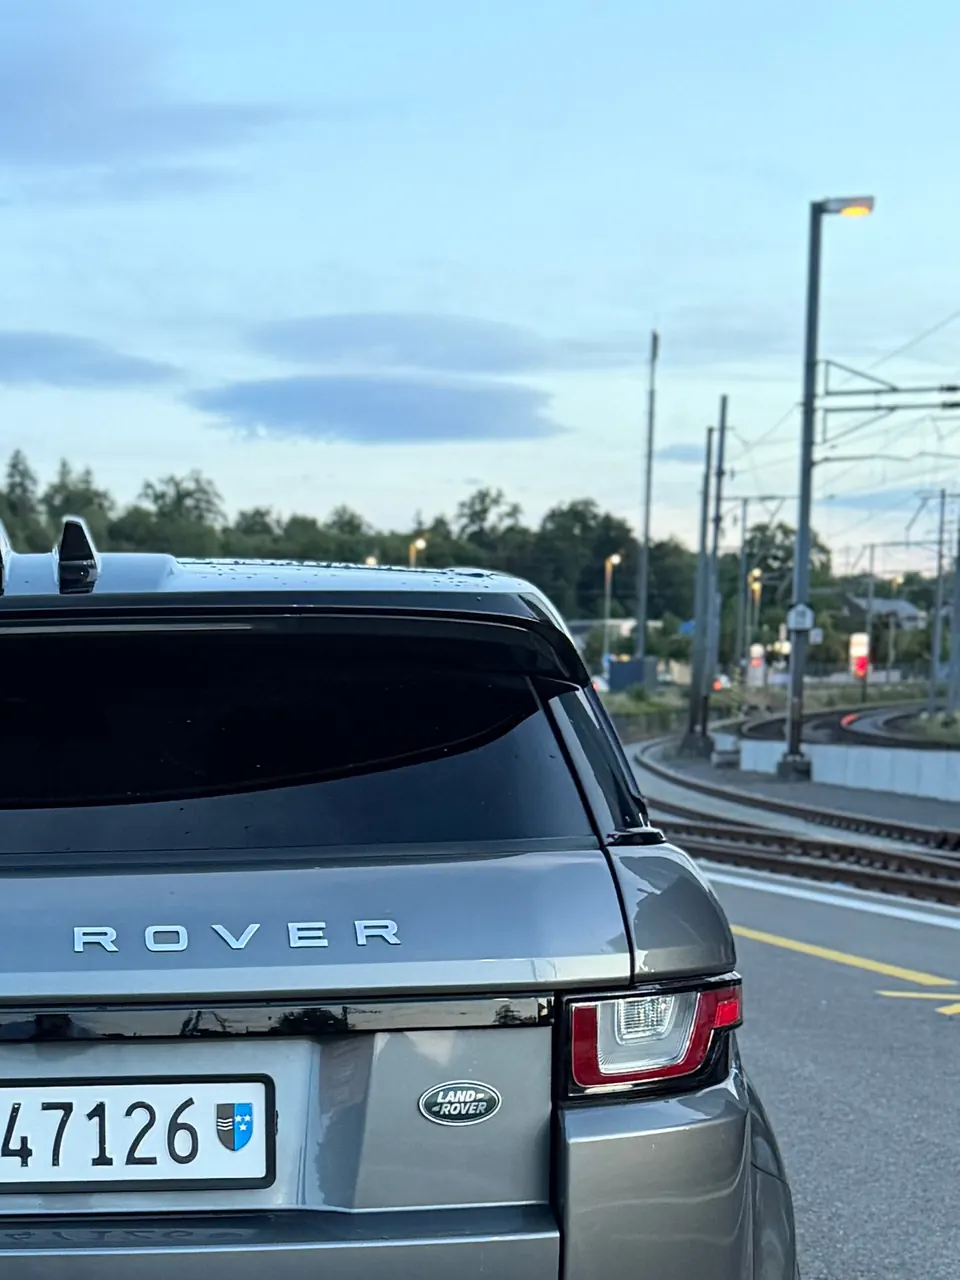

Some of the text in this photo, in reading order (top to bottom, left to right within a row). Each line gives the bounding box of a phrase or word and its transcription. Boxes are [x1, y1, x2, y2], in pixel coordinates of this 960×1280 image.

[73, 920, 401, 952] ROVER
[437, 1090, 476, 1103] LAND
[439, 1101, 488, 1115] ROVER
